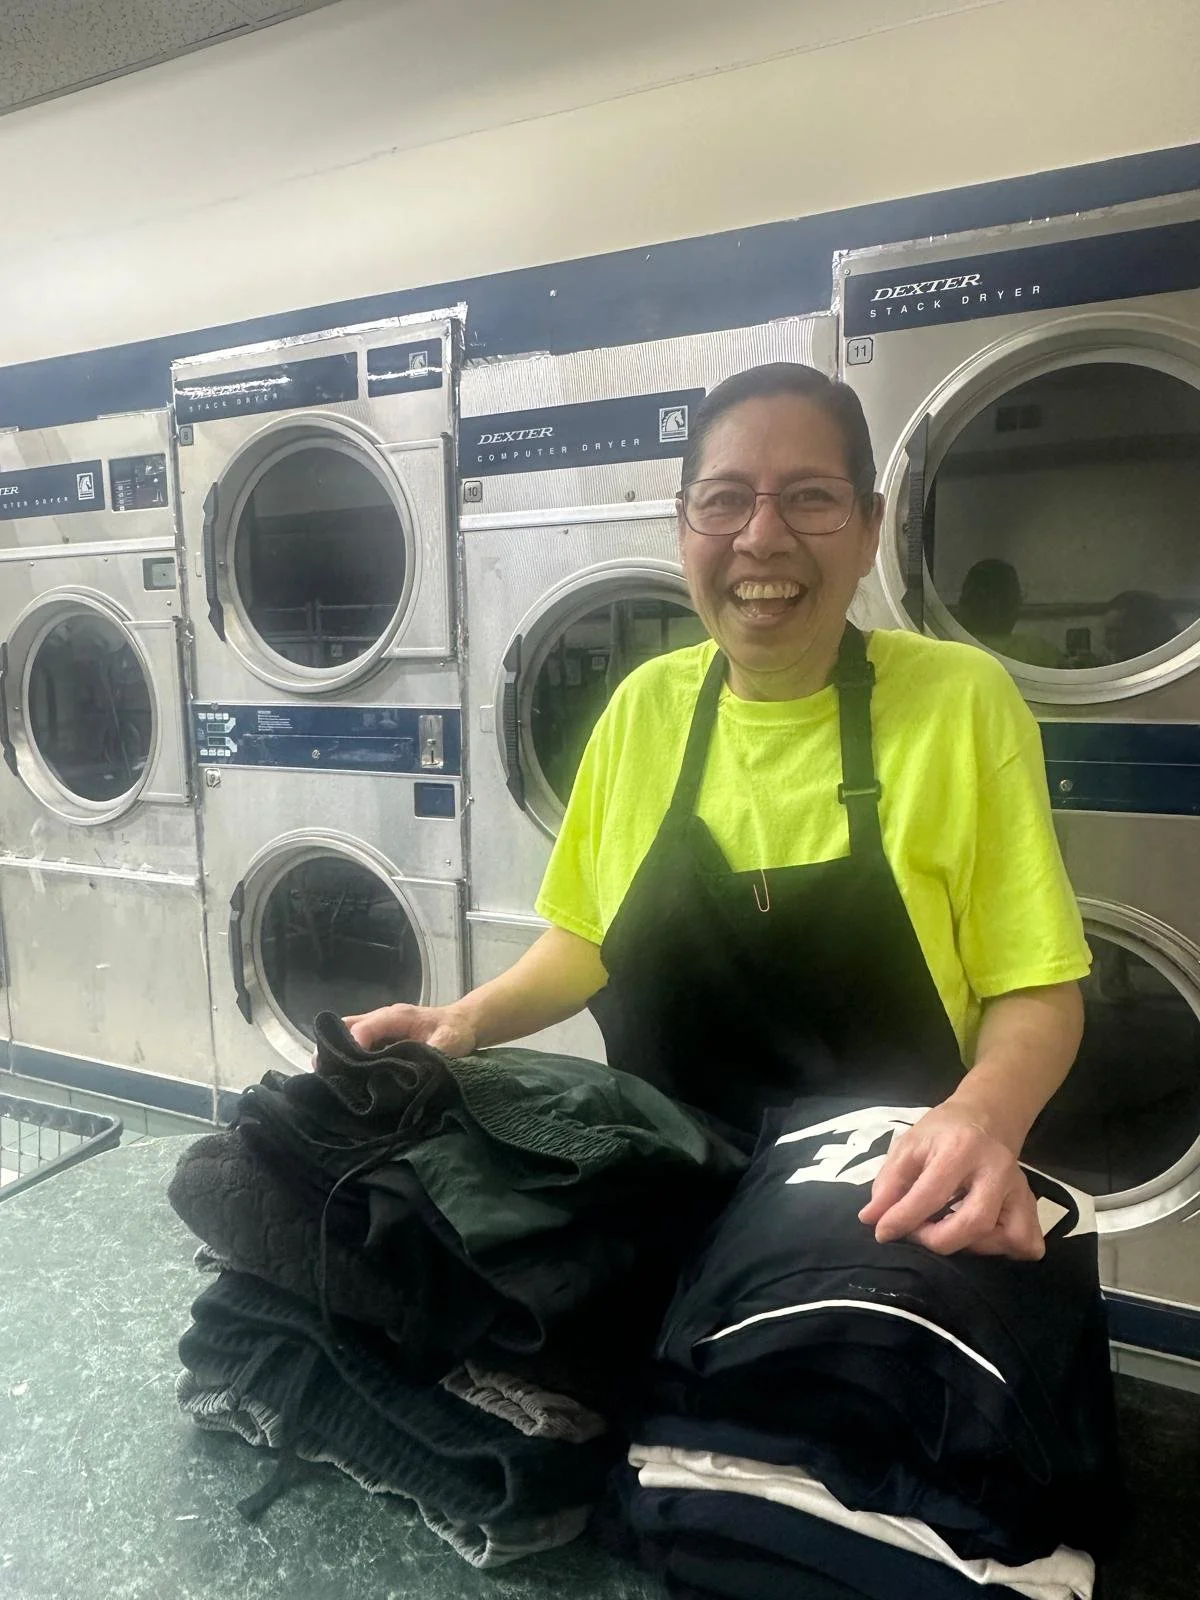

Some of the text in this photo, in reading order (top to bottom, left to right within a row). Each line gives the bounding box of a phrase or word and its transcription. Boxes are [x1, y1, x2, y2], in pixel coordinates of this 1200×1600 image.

[870, 273, 981, 302] DEXTER
[870, 285, 1040, 318] STACK DRYER
[854, 345, 866, 358] 11
[477, 427, 554, 446] DEXTER
[477, 438, 640, 463] COMPUTER DRYER
[467, 486, 478, 497] 10
